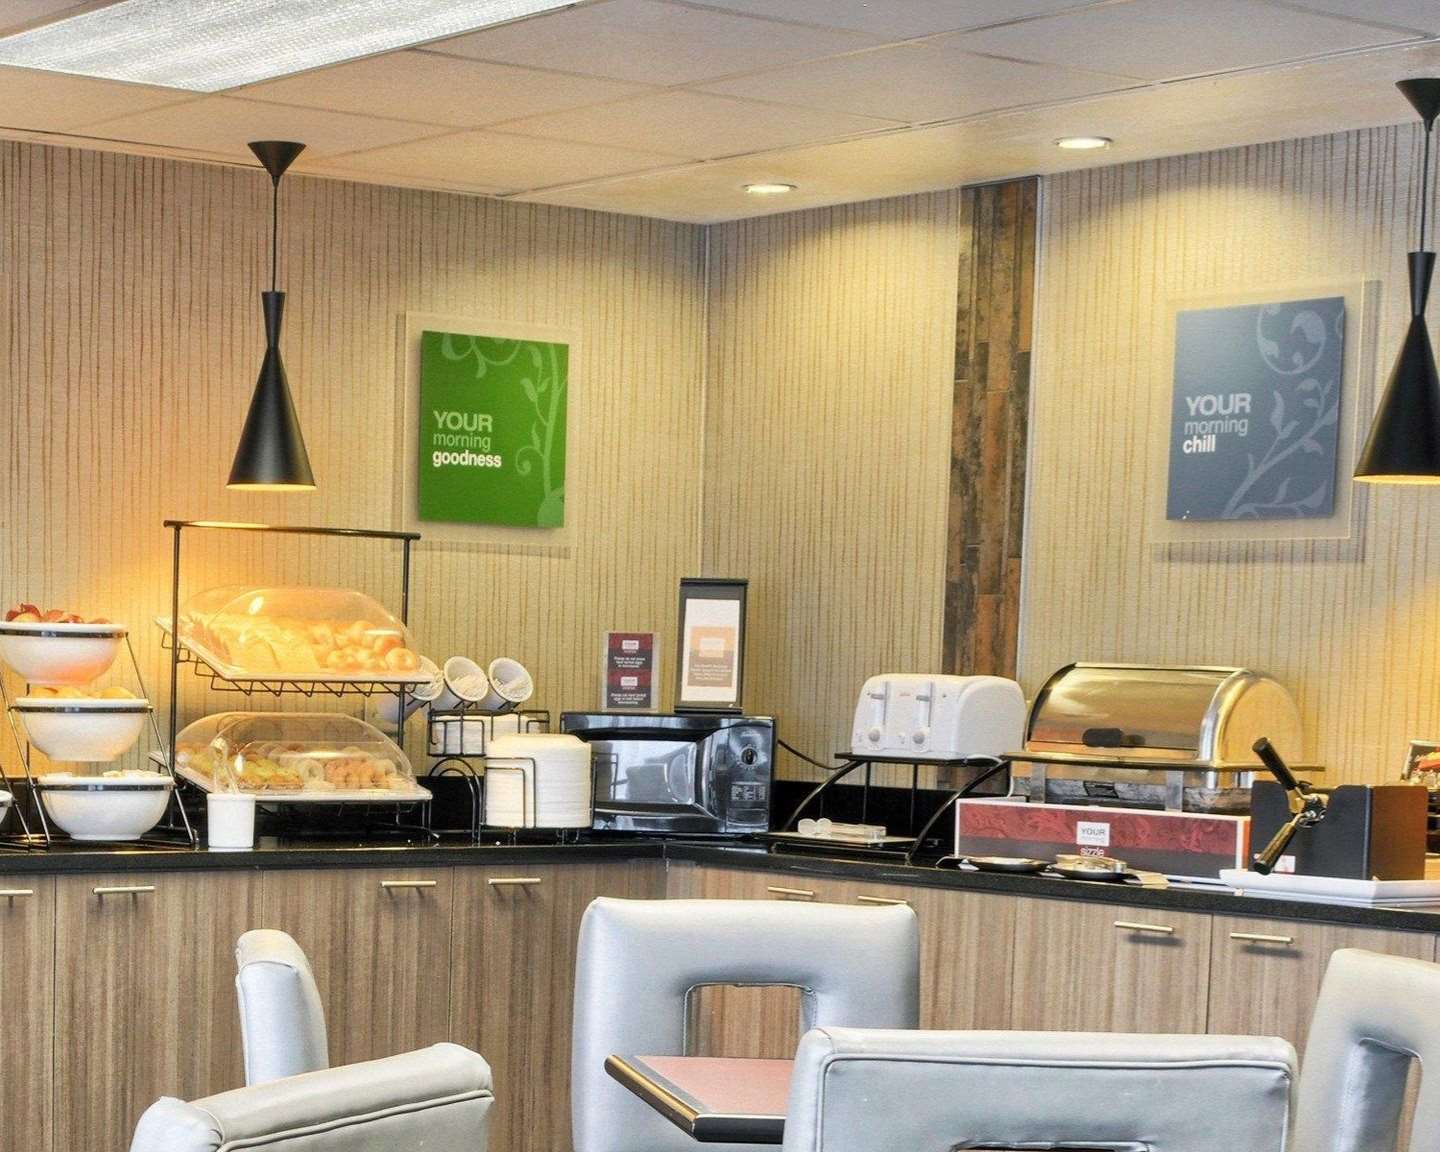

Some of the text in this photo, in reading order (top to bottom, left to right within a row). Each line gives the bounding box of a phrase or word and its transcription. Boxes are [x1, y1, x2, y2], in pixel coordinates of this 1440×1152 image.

[1185, 392, 1252, 416] YOUR
[433, 410, 493, 432] YOUR
[1184, 416, 1249, 437] morning
[433, 433, 492, 453] morning
[1183, 434, 1216, 454] chill
[433, 449, 502, 468] goodness
[1081, 828, 1106, 836] YOUR
[1080, 847, 1105, 858] sizzle
